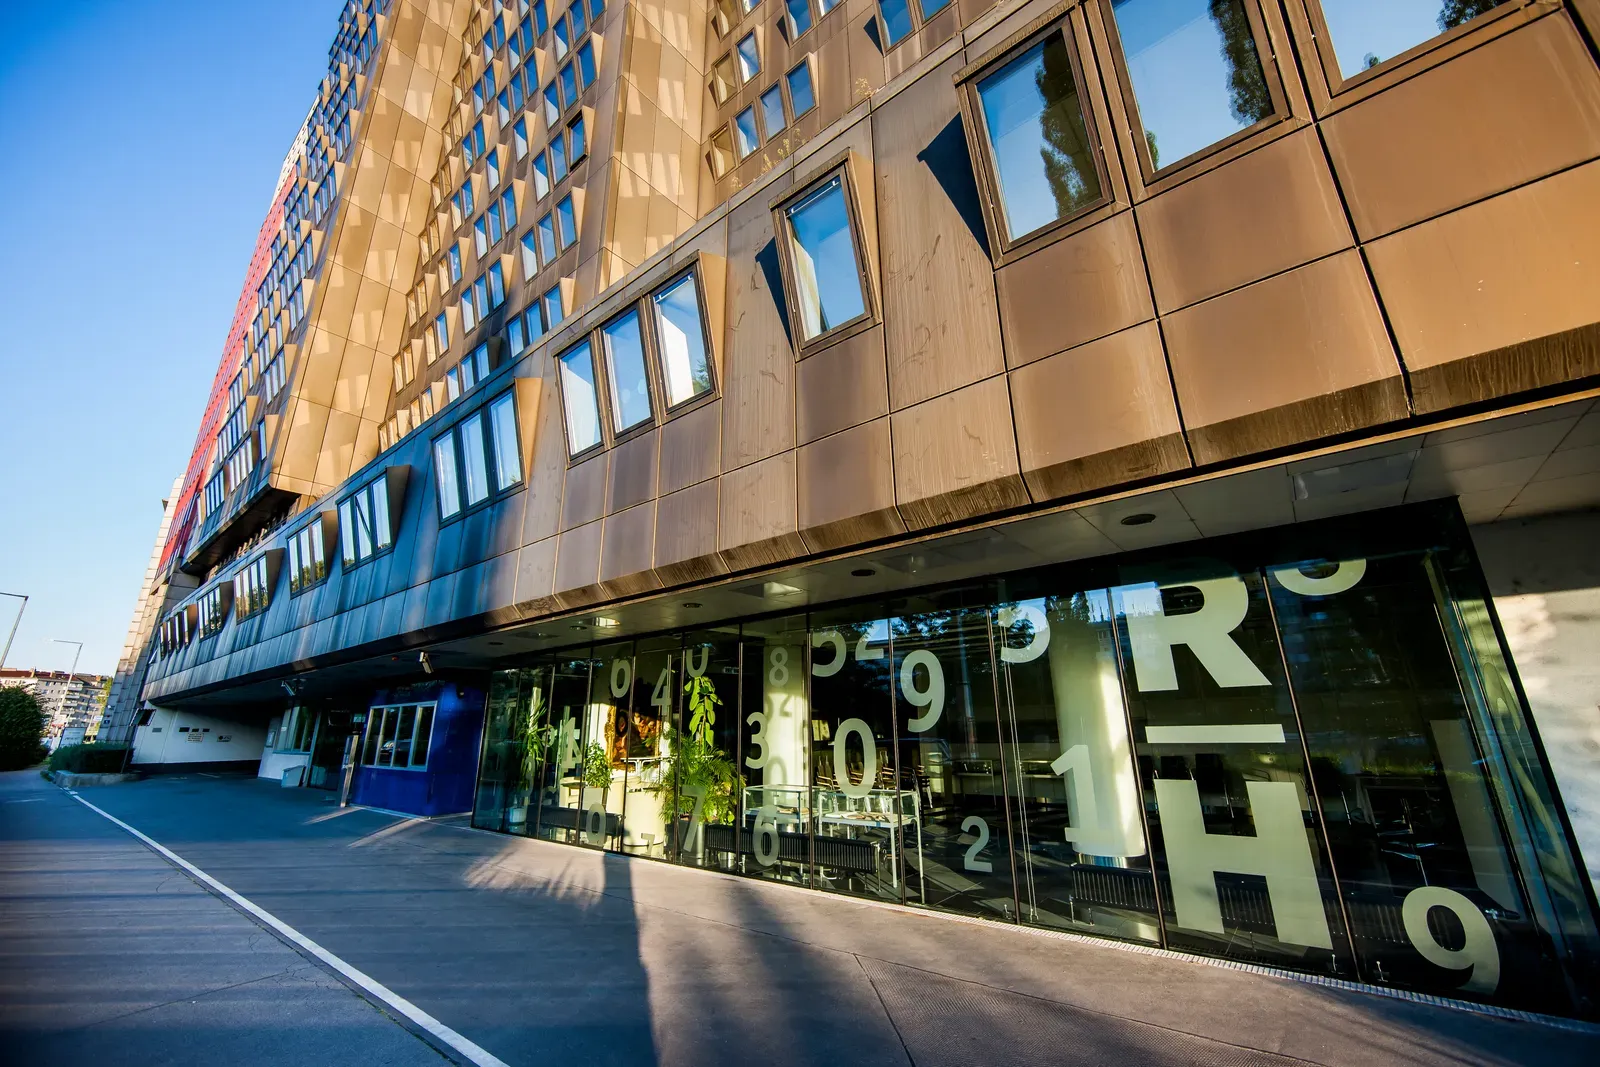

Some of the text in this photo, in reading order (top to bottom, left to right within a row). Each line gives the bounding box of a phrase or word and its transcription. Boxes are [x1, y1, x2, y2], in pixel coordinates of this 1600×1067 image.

[769, 646, 789, 687] 8
[1121, 573, 1273, 693] R
[650, 668, 671, 717] 4
[900, 649, 946, 733] 9
[745, 711, 770, 769] 3
[834, 717, 877, 798] 0
[585, 802, 607, 848] 0
[681, 784, 707, 853] 7
[1050, 743, 1113, 846] 1
[753, 804, 780, 867] 6
[960, 815, 993, 873] 2
[1153, 778, 1334, 951] H
[1402, 886, 1500, 995] 9
